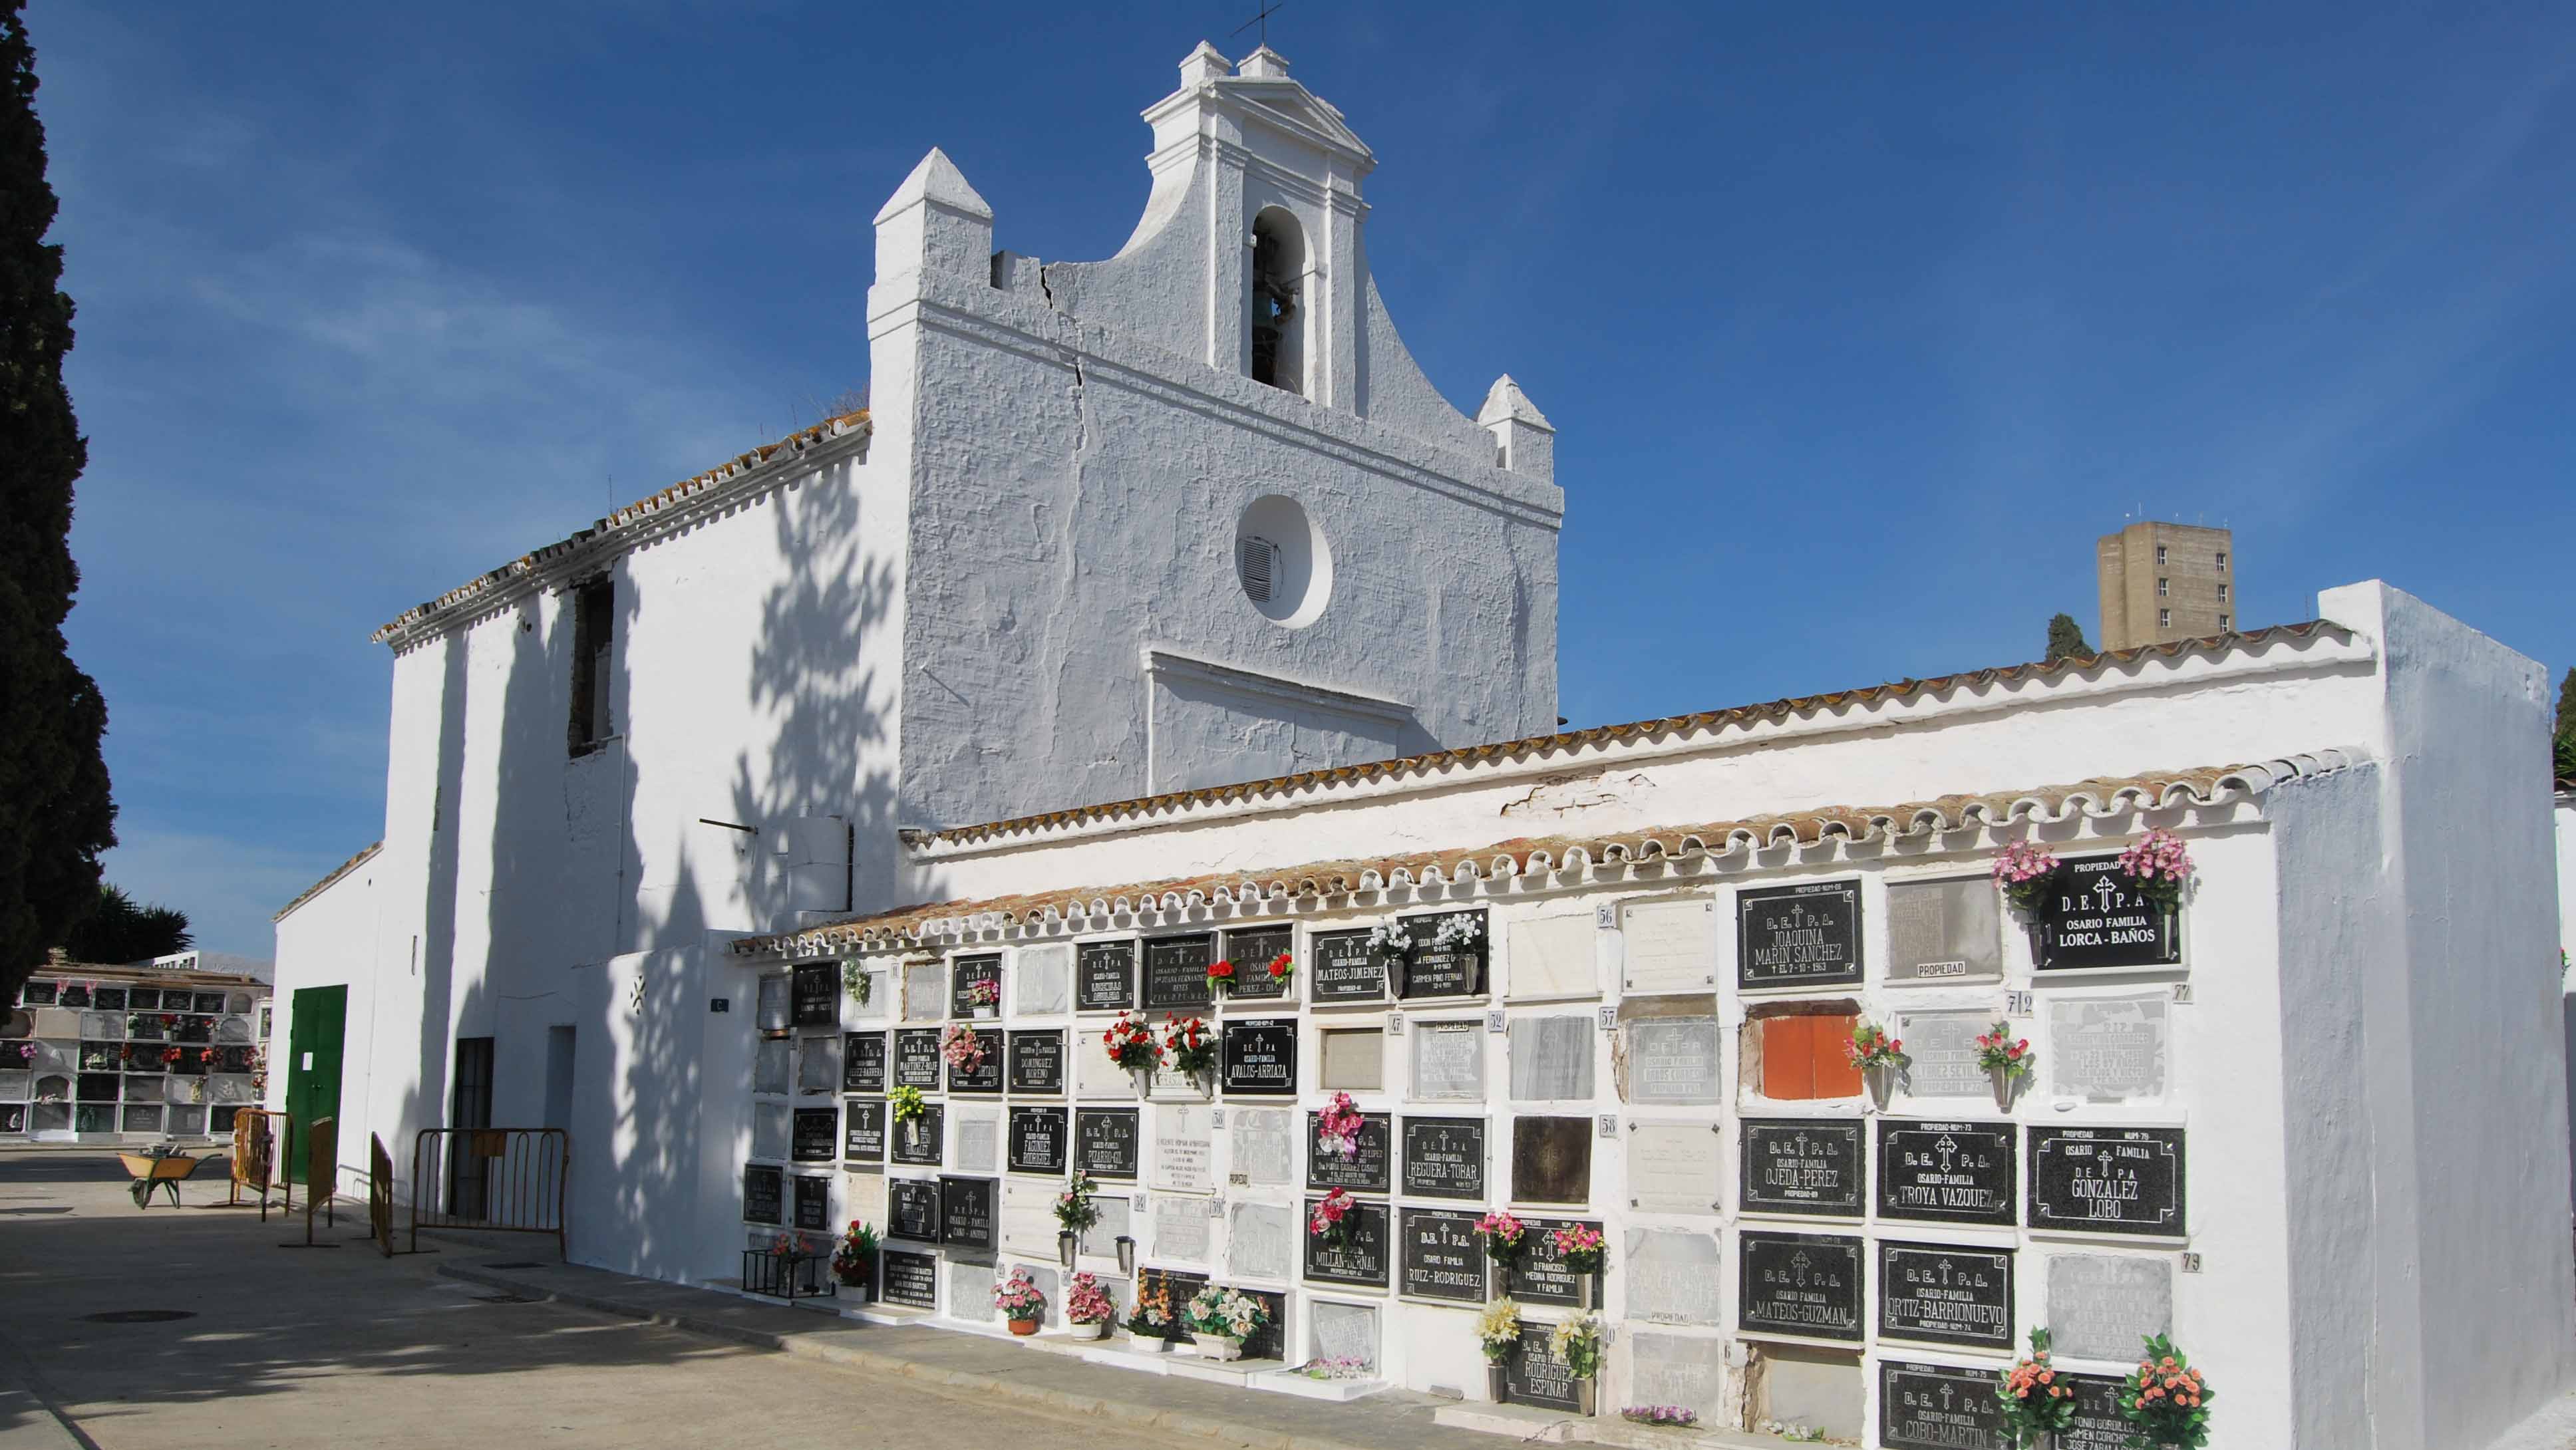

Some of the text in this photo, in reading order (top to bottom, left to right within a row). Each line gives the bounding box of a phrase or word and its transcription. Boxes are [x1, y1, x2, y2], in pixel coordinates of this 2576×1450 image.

[2074, 861, 2121, 873] PROPIEDAD
[1600, 911, 1612, 925] 56
[1767, 913, 1834, 929] D. E. P. A.
[2066, 916, 2147, 930] OSARIO FAMILIA
[1772, 929, 1824, 947] JOAQUINA
[2060, 933, 2102, 947] LORCA
[2111, 929, 2156, 944] BAÑOS
[1756, 943, 1842, 965] MARIN SANCHEZ
[1250, 962, 1269, 972] OSARI
[1317, 966, 1383, 981] MATEOS-JIMENEZ
[1919, 963, 1963, 976] PROPIEDAD
[1239, 984, 1260, 993] PEREZ
[2173, 984, 2190, 1001] 77
[1491, 1014, 1502, 1028] 52
[1601, 1010, 1614, 1026] 57
[1022, 1058, 1052, 1068] DOMINGUEZ
[1231, 1064, 1287, 1078] AVALOS-ARRIAZA
[1603, 1118, 1615, 1133] 58
[1770, 1141, 1838, 1155] D. E. P. A.
[2066, 1145, 2150, 1159] OSARIO FAMILIA
[1088, 1150, 1123, 1164] PIZARRO-GIL
[1777, 1159, 1827, 1169] OSARIO-FAMILIA
[1905, 1152, 1990, 1168] D. E. P. A.
[1410, 1161, 1477, 1180] REGUERA-TOBAR
[1766, 1168, 1838, 1187] OJEDA-PEREZ
[1917, 1173, 1974, 1185] OSARIO-FAMILIA
[2072, 1178, 2138, 1200] GONZALEZ
[1900, 1186, 1994, 1208] TROYA VAZQUEZ
[2088, 1199, 2122, 1219] LOBO
[1316, 1251, 1377, 1272] MILLAN-BERNAL
[1424, 1254, 1463, 1266] OSARIO FAMILIA
[1526, 1271, 1576, 1284] MEDINA RODRIGUEZ
[1765, 1270, 1841, 1287] D. E. P. A.
[1907, 1268, 1988, 1287] D. E. P. A.
[1537, 1283, 1564, 1294] Y FAMILIA
[1916, 1288, 1973, 1302] OSARIO-FAMILIA
[1776, 1290, 1827, 1304] OSARIO FAMILIA
[1756, 1301, 1847, 1325] MATEOS-GUZMAN
[1888, 1298, 2004, 1324] ORTIZ-BARRIONUEVO
[1533, 1341, 1542, 1352] E.
[1528, 1352, 1547, 1362] OSARIO
[1525, 1362, 1573, 1383] RODRIGUEZ
[1906, 1364, 1935, 1373] PROPIEDAD
[1530, 1378, 1569, 1398] ESPINAR
[1905, 1391, 1995, 1414] D. E. P. A.
[1917, 1409, 1975, 1427] OSARIO-FAMILIA
[2075, 1417, 2096, 1429] TONIO
[1905, 1420, 1988, 1448] COBO-MARTIN
